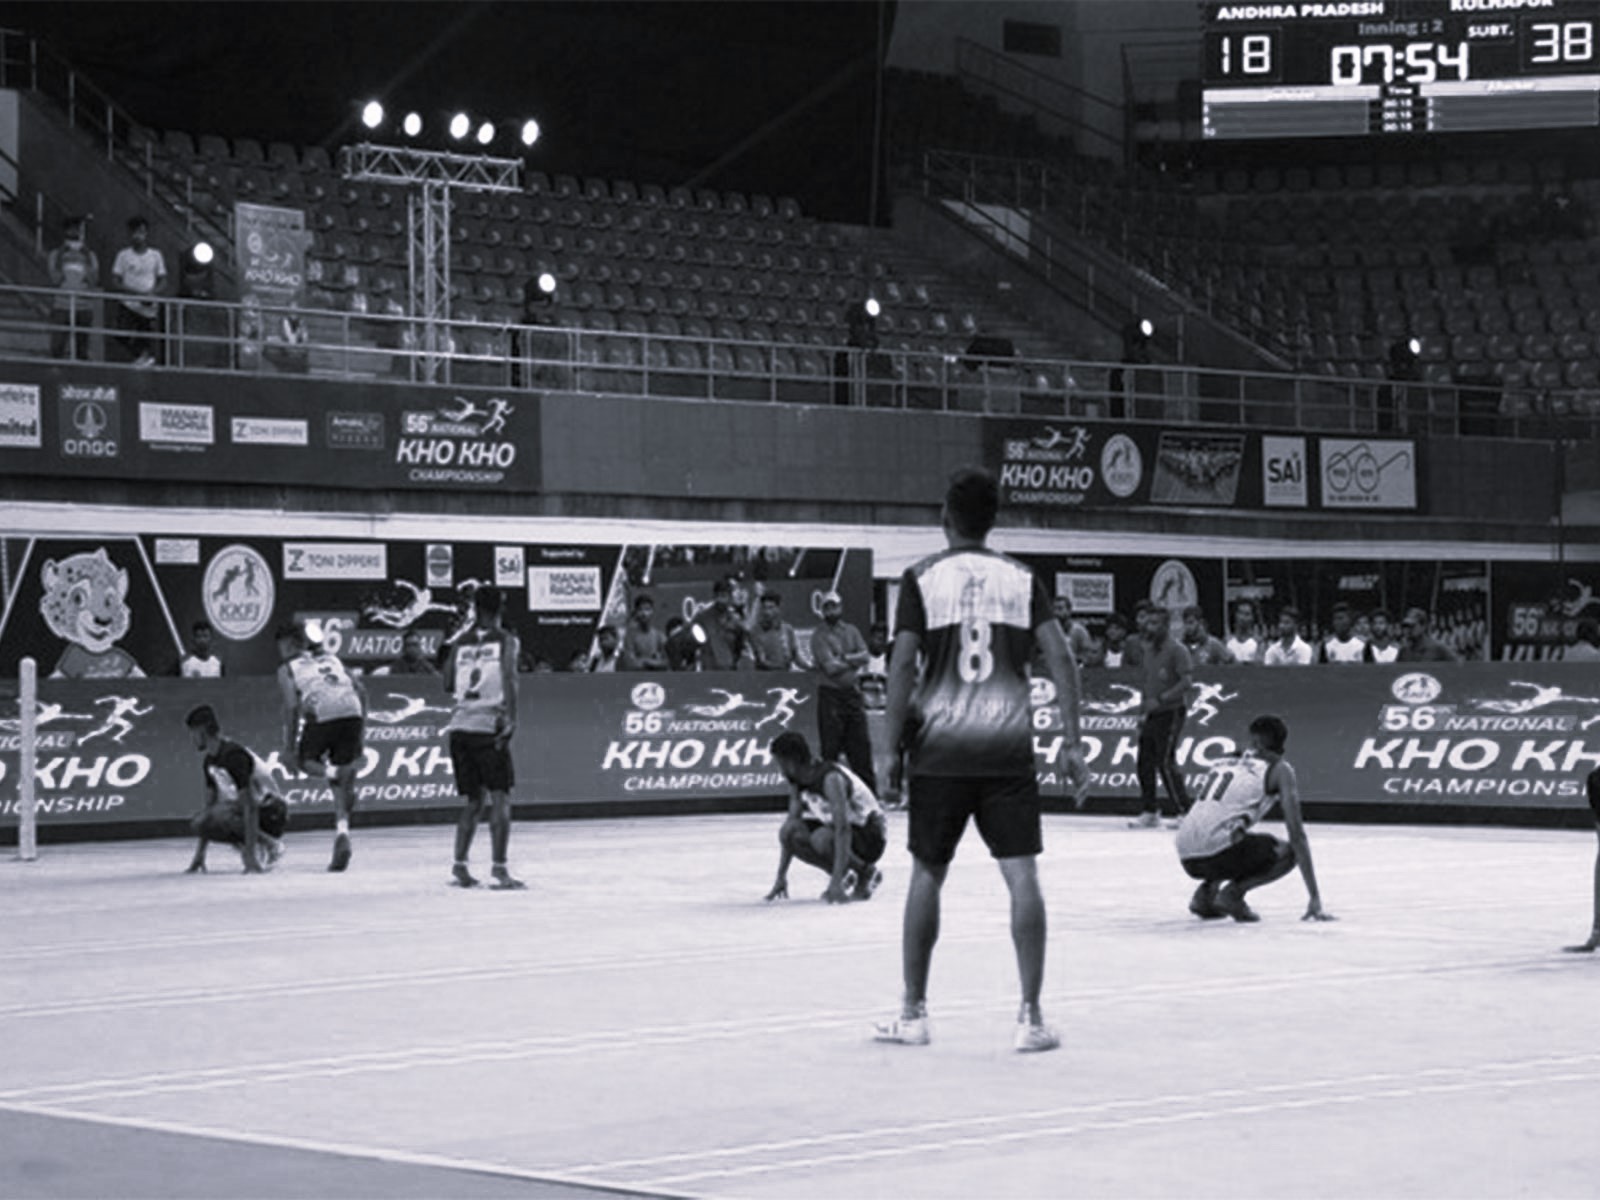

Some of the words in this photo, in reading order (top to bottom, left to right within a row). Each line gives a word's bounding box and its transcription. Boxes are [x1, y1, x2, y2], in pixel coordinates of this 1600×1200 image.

[1217, 5, 1297, 20] ANDHRA
[1301, 2, 1384, 17] PRADESH
[1358, 22, 1418, 36] Inning
[1468, 24, 1514, 38] SUBT.
[1222, 35, 1271, 74] 18
[1531, 22, 1592, 63] 38
[1331, 42, 1468, 86] 07:54
[396, 440, 455, 464] KHO
[458, 441, 516, 468] KHO
[409, 468, 504, 483] CHAMPIONSHIP
[1000, 463, 1046, 488] KHO
[1048, 465, 1094, 491] KHO
[287, 548, 305, 572] Z
[307, 554, 334, 568] TONI
[349, 634, 438, 654] NATIOAL
[958, 618, 995, 684] 8
[666, 720, 748, 733] NATIONAL
[1443, 716, 1570, 732] NATIONAL
[387, 745, 454, 777] KH
[601, 738, 706, 770] KHO
[710, 737, 777, 767] KH
[1353, 737, 1500, 771] KHO
[284, 783, 459, 805] CHAPIONSH
[1383, 777, 1589, 796] CHAMPIONS
